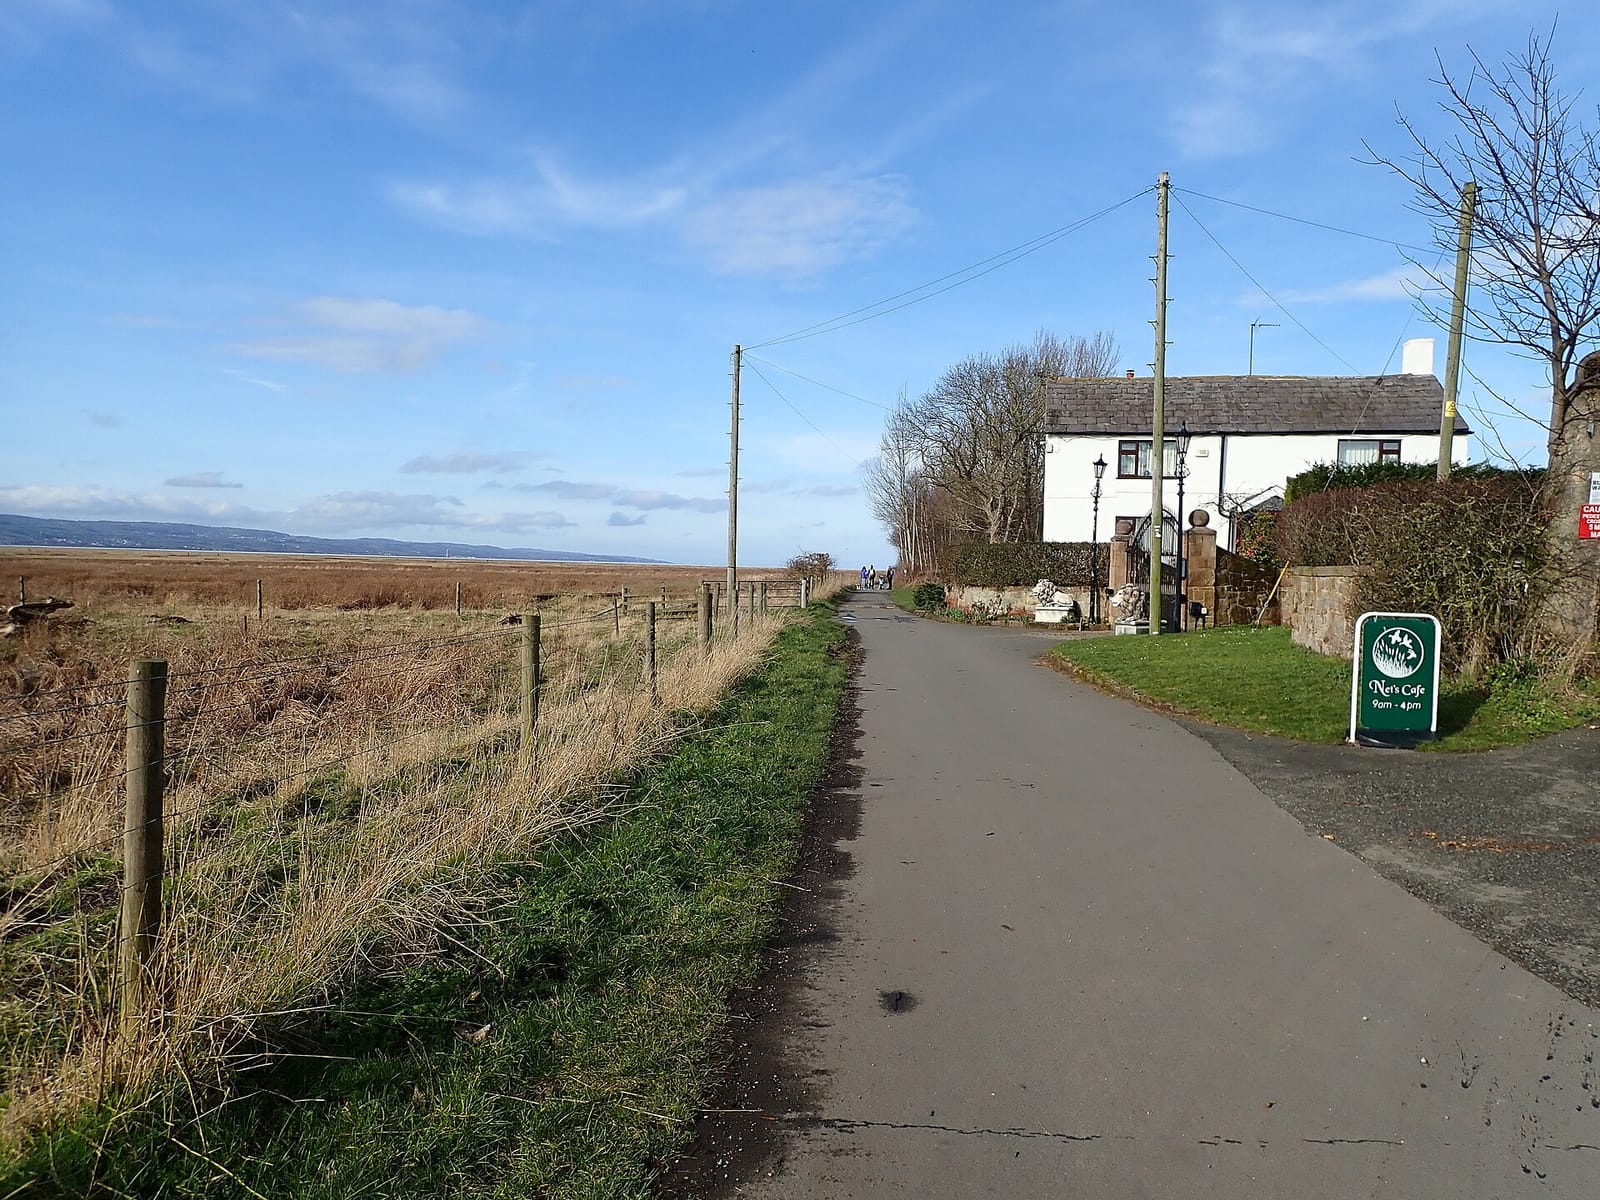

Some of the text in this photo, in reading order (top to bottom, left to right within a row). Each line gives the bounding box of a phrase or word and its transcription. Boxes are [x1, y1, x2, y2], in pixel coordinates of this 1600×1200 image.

[1368, 679, 1426, 698] Net's Cafe
[1372, 699, 1392, 709] 9am
[1400, 701, 1421, 711] 4pm
